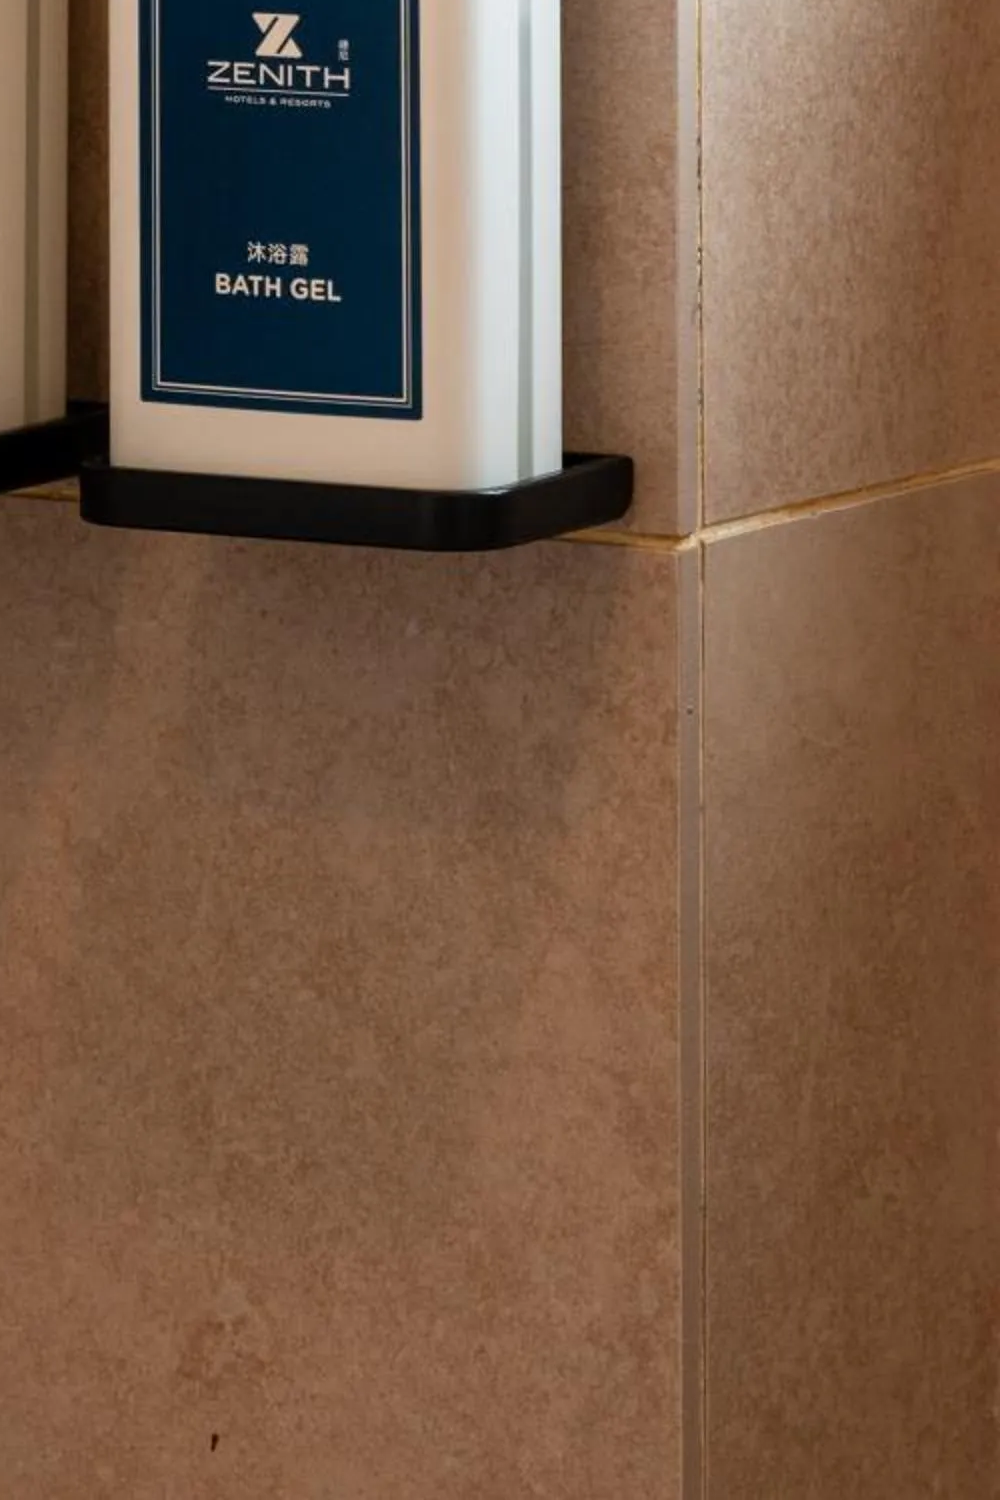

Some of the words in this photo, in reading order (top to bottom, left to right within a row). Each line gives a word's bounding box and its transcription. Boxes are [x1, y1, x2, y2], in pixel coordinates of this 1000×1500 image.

[207, 61, 350, 90] ZENITH
[225, 95, 266, 105] HOTELS
[279, 98, 332, 109] RESORTS
[247, 241, 309, 267] 沐浴露
[215, 272, 282, 298] BATH
[290, 277, 342, 302] GEL
